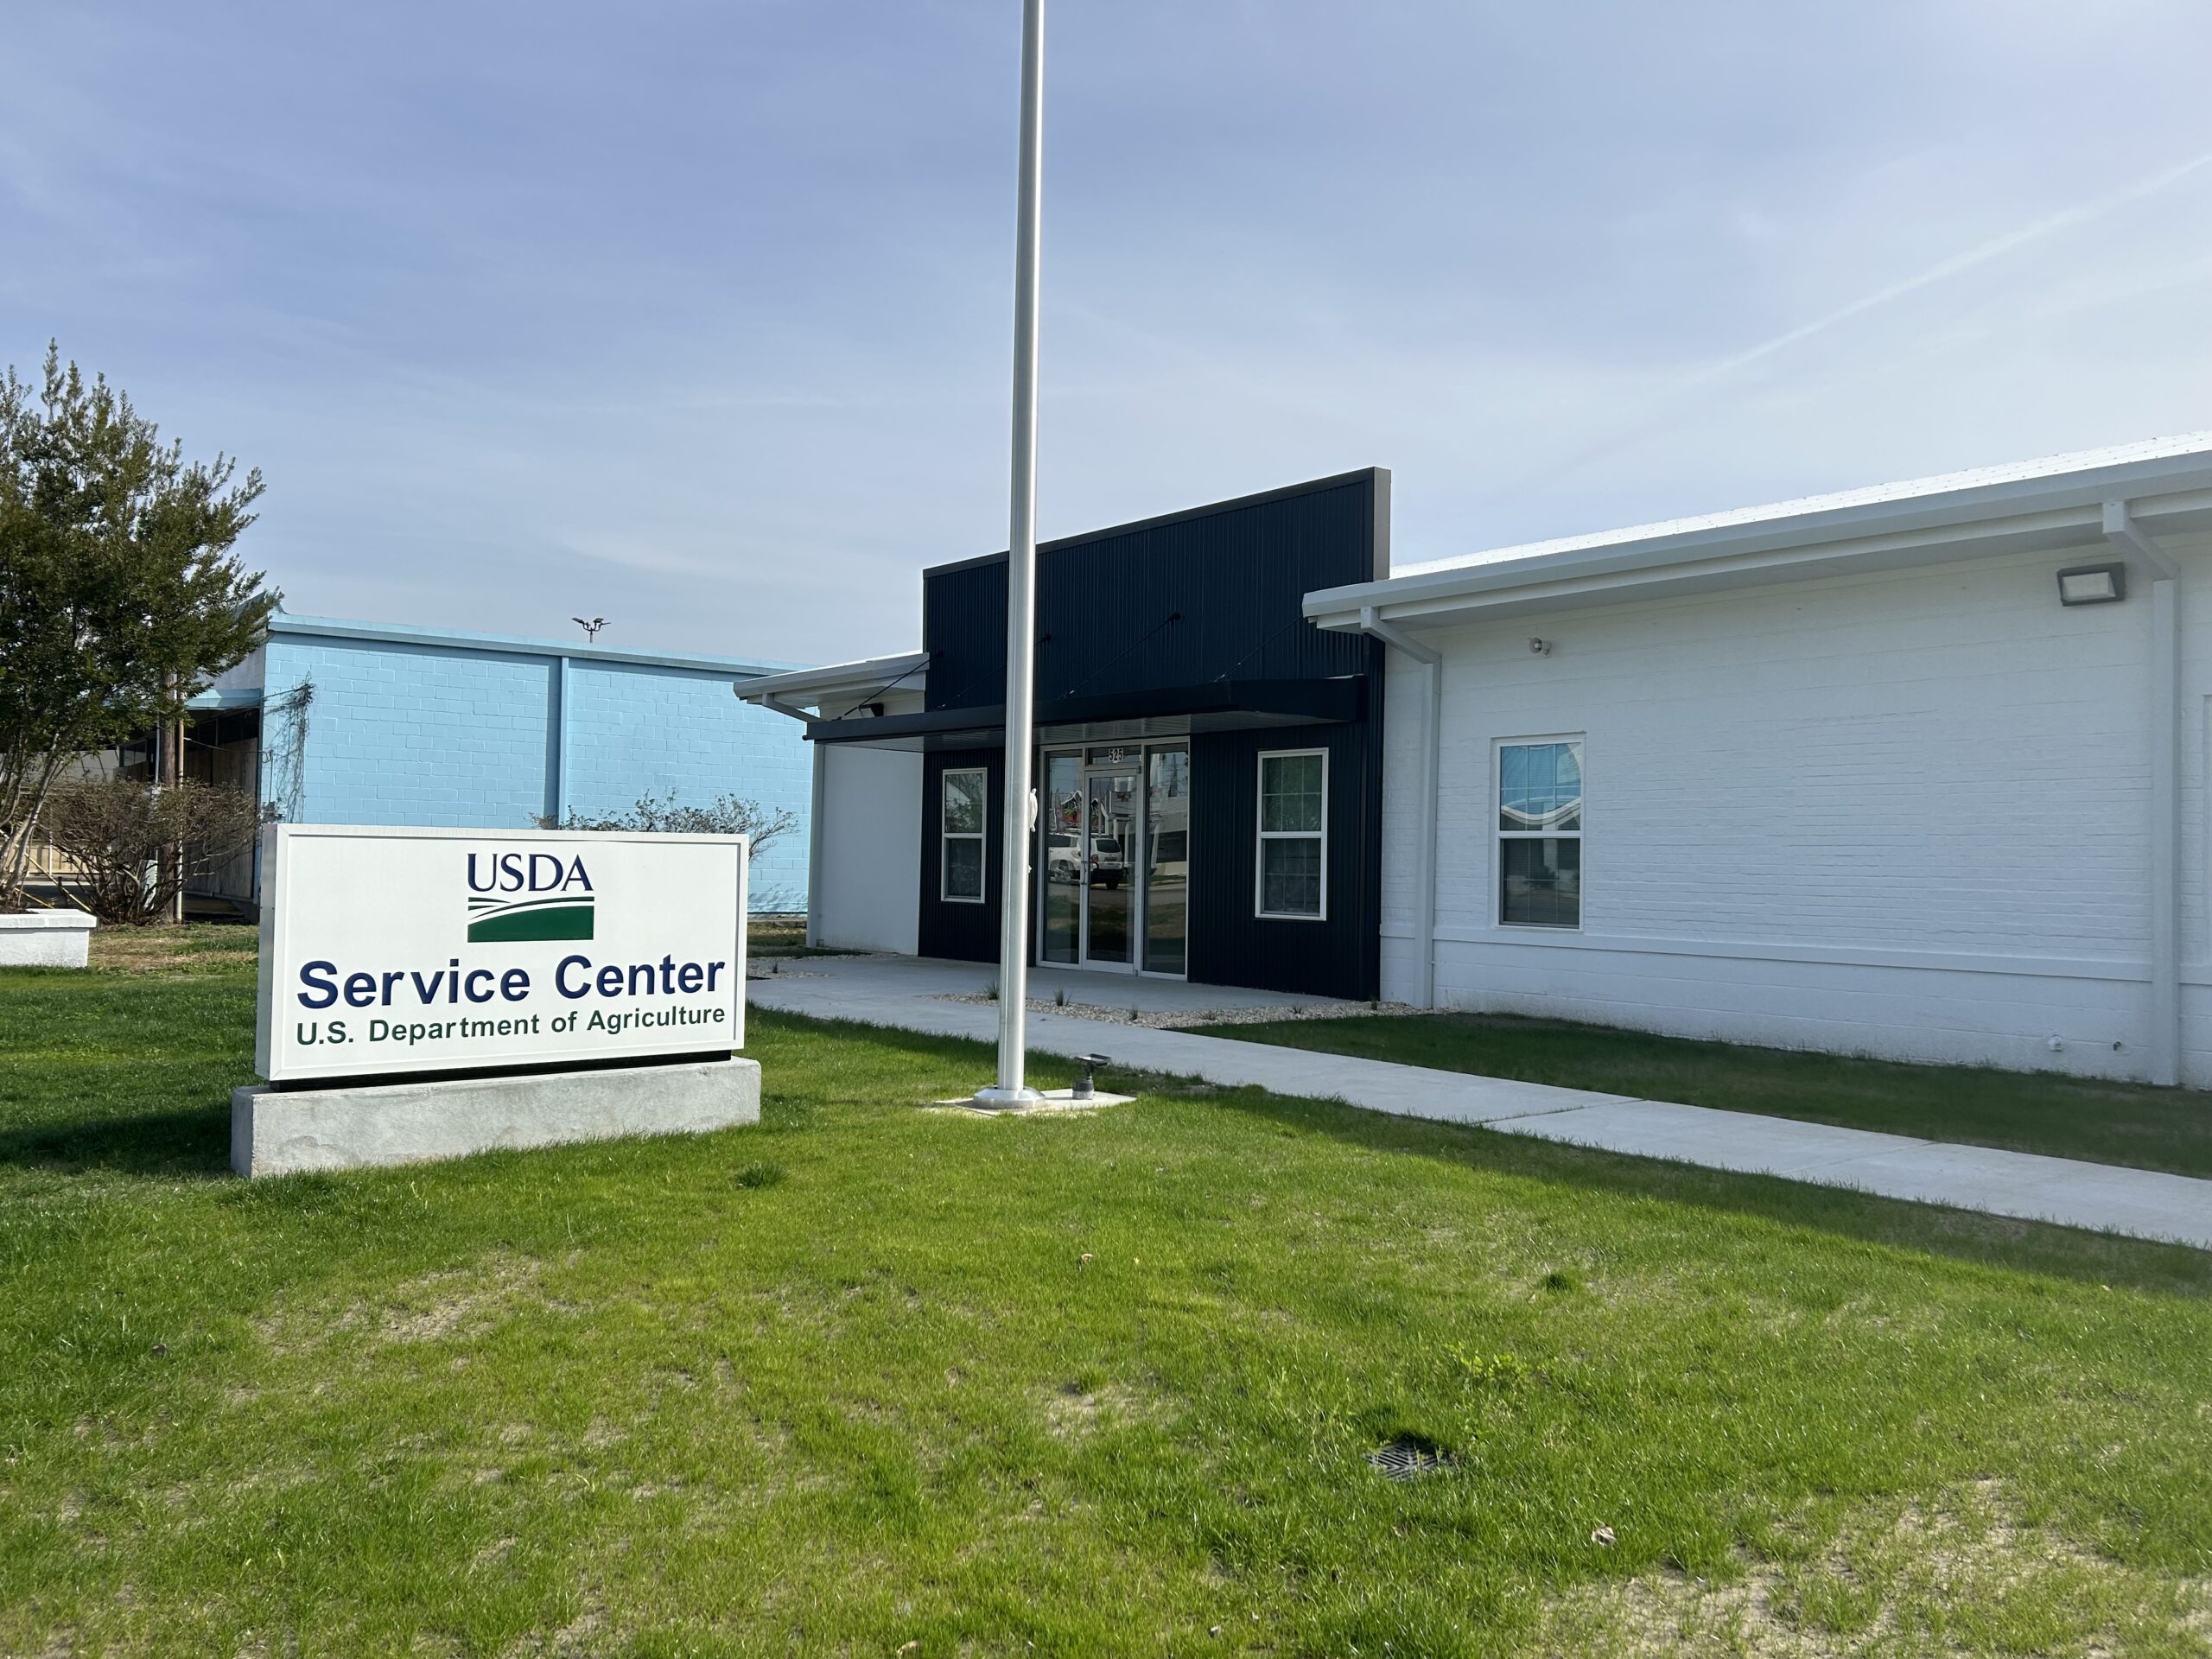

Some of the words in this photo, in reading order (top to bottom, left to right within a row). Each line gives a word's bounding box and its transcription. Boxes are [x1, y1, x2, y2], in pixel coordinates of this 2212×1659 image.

[1109, 748, 1123, 761] 525
[467, 853, 594, 893] USDA
[296, 958, 531, 1009] Service
[555, 953, 726, 1000] Center
[296, 1020, 354, 1046] U.S.
[369, 1014, 540, 1046] Department
[550, 1010, 578, 1033] of
[586, 1005, 725, 1033] Agriculture
